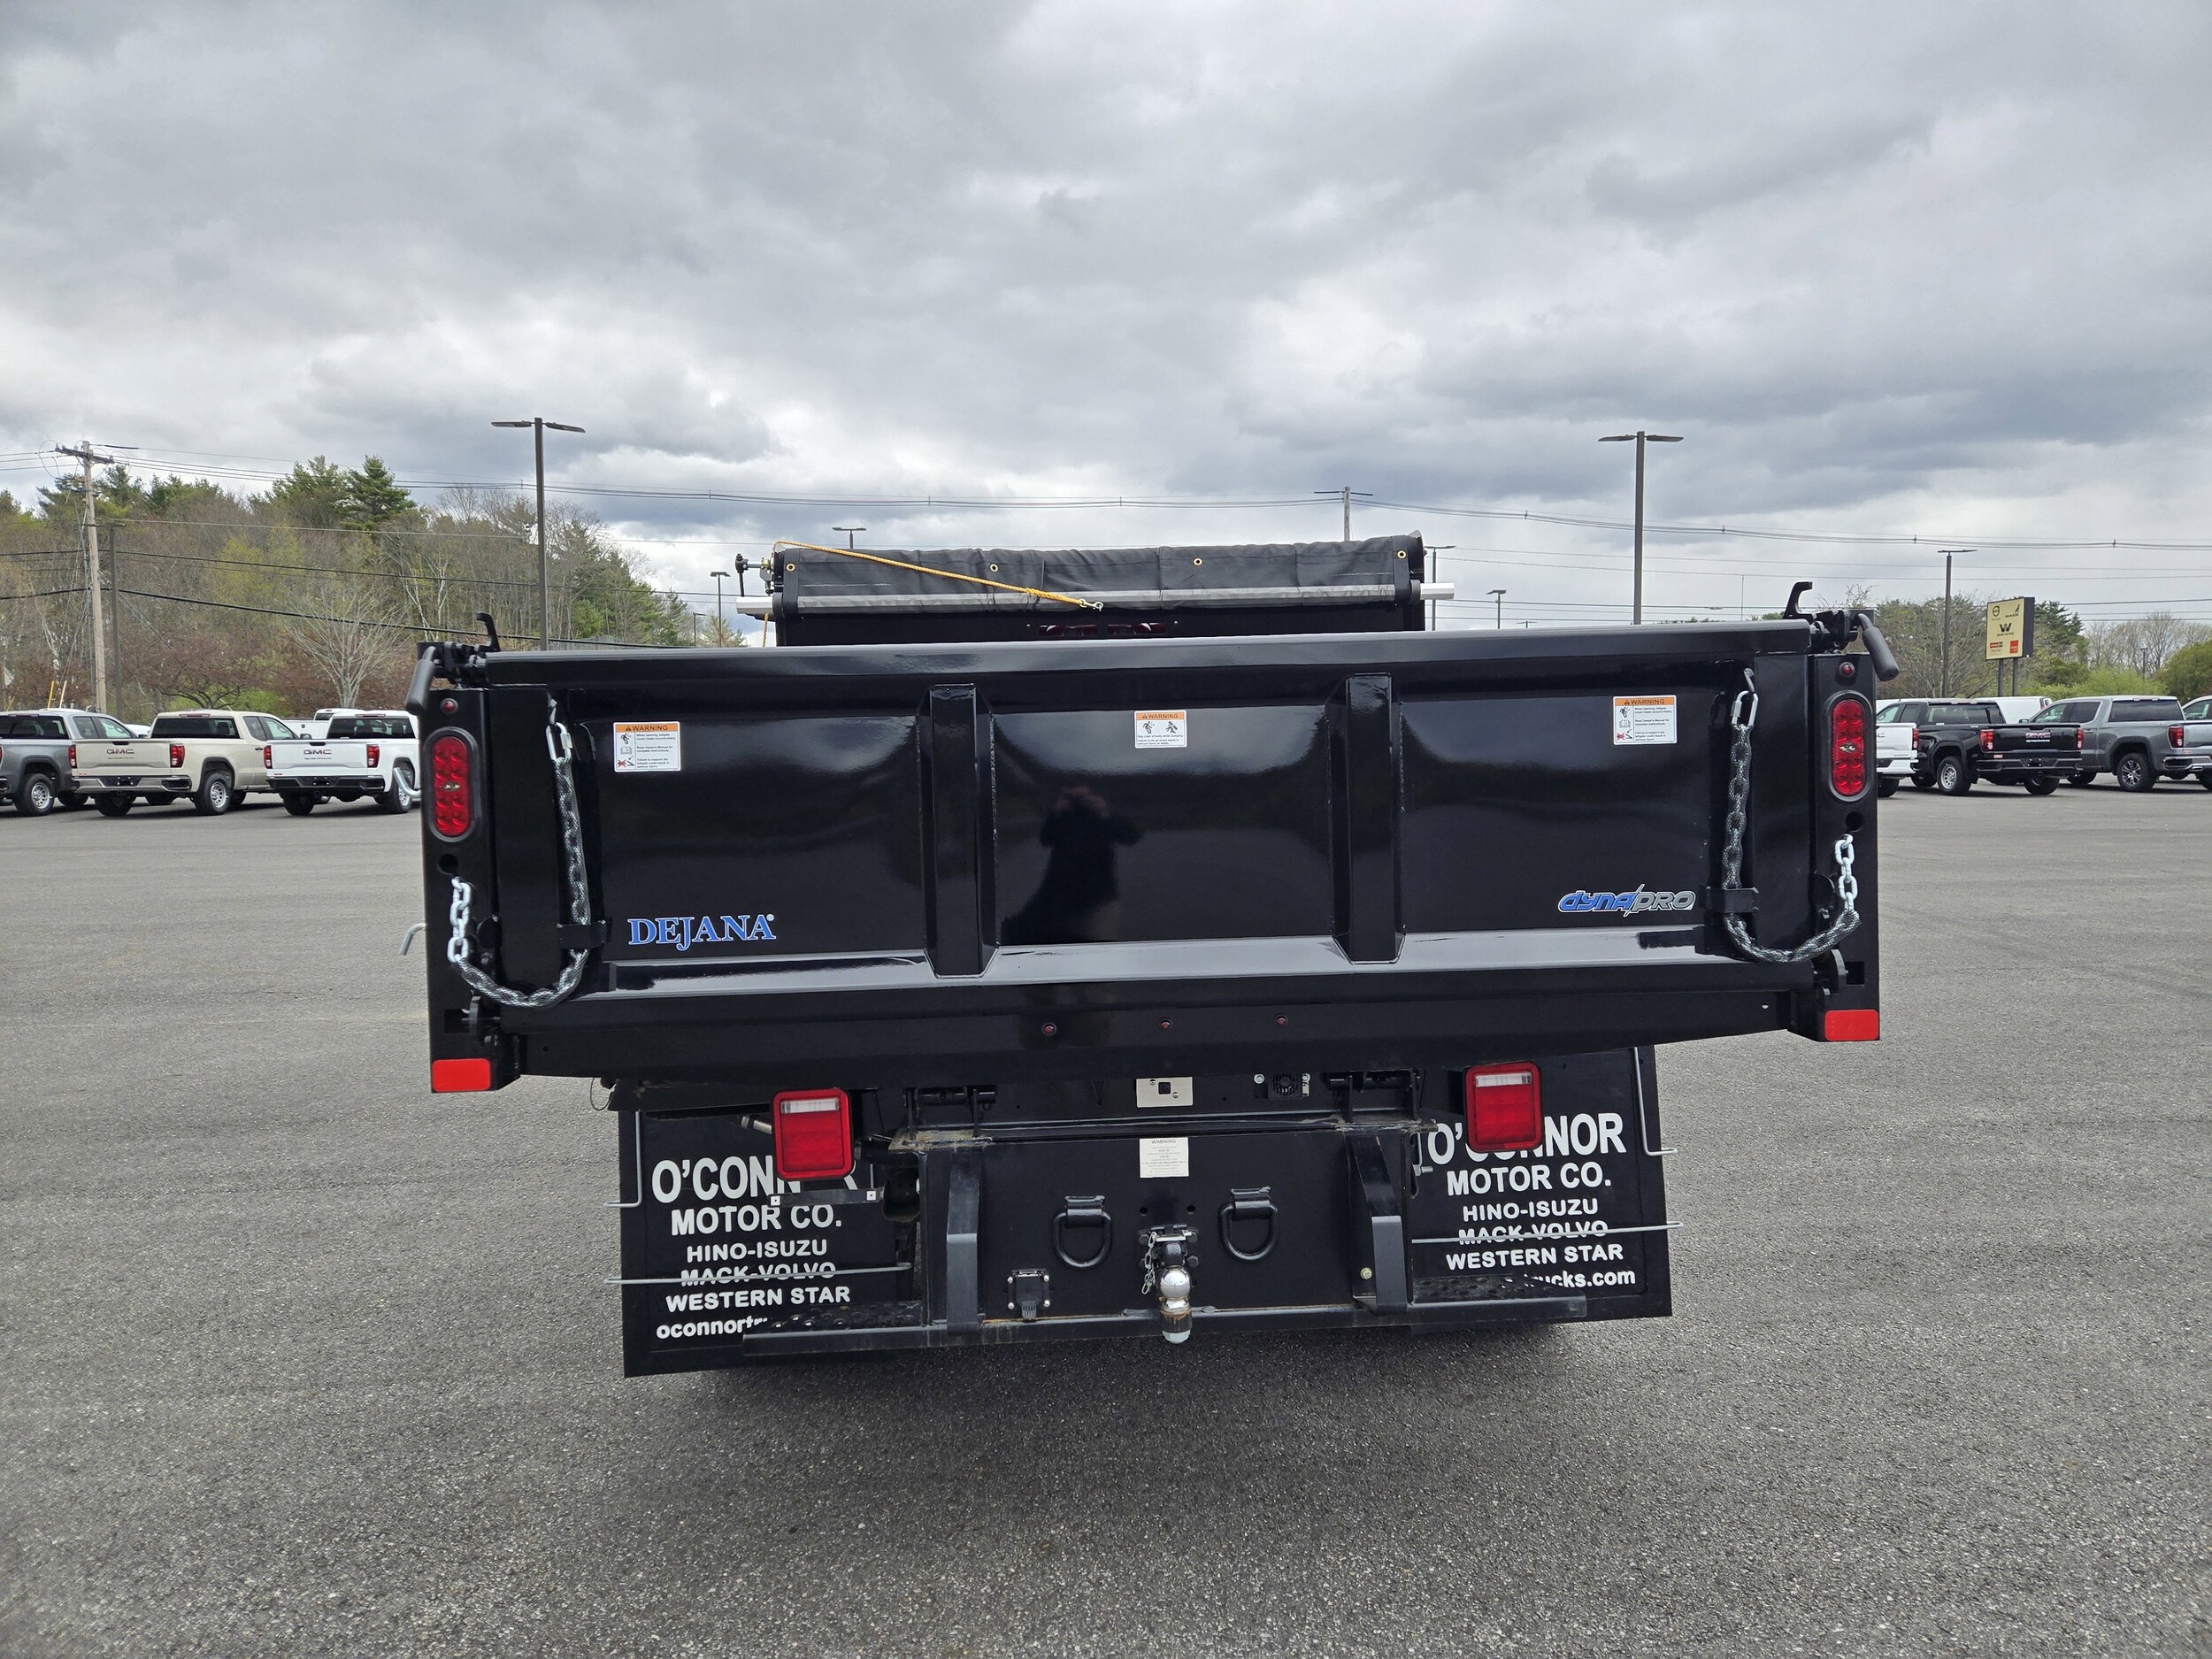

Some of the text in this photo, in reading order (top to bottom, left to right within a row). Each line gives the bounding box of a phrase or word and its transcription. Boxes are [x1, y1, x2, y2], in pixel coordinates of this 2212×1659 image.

[1427, 1112, 1627, 1165] O'NOR
[1447, 1161, 1612, 1196] MOTOR CO.
[671, 1204, 842, 1236] MOTOR CO.
[1463, 1198, 1599, 1223] HINO-ISUZU
[1459, 1220, 1609, 1246] MACK-VOLVO
[687, 1239, 828, 1263] HINO-ISUZU
[1446, 1243, 1624, 1271] WESTERN STAR
[680, 1262, 836, 1286] MACK-VOLVO
[665, 1286, 850, 1313] WESTERN STAR
